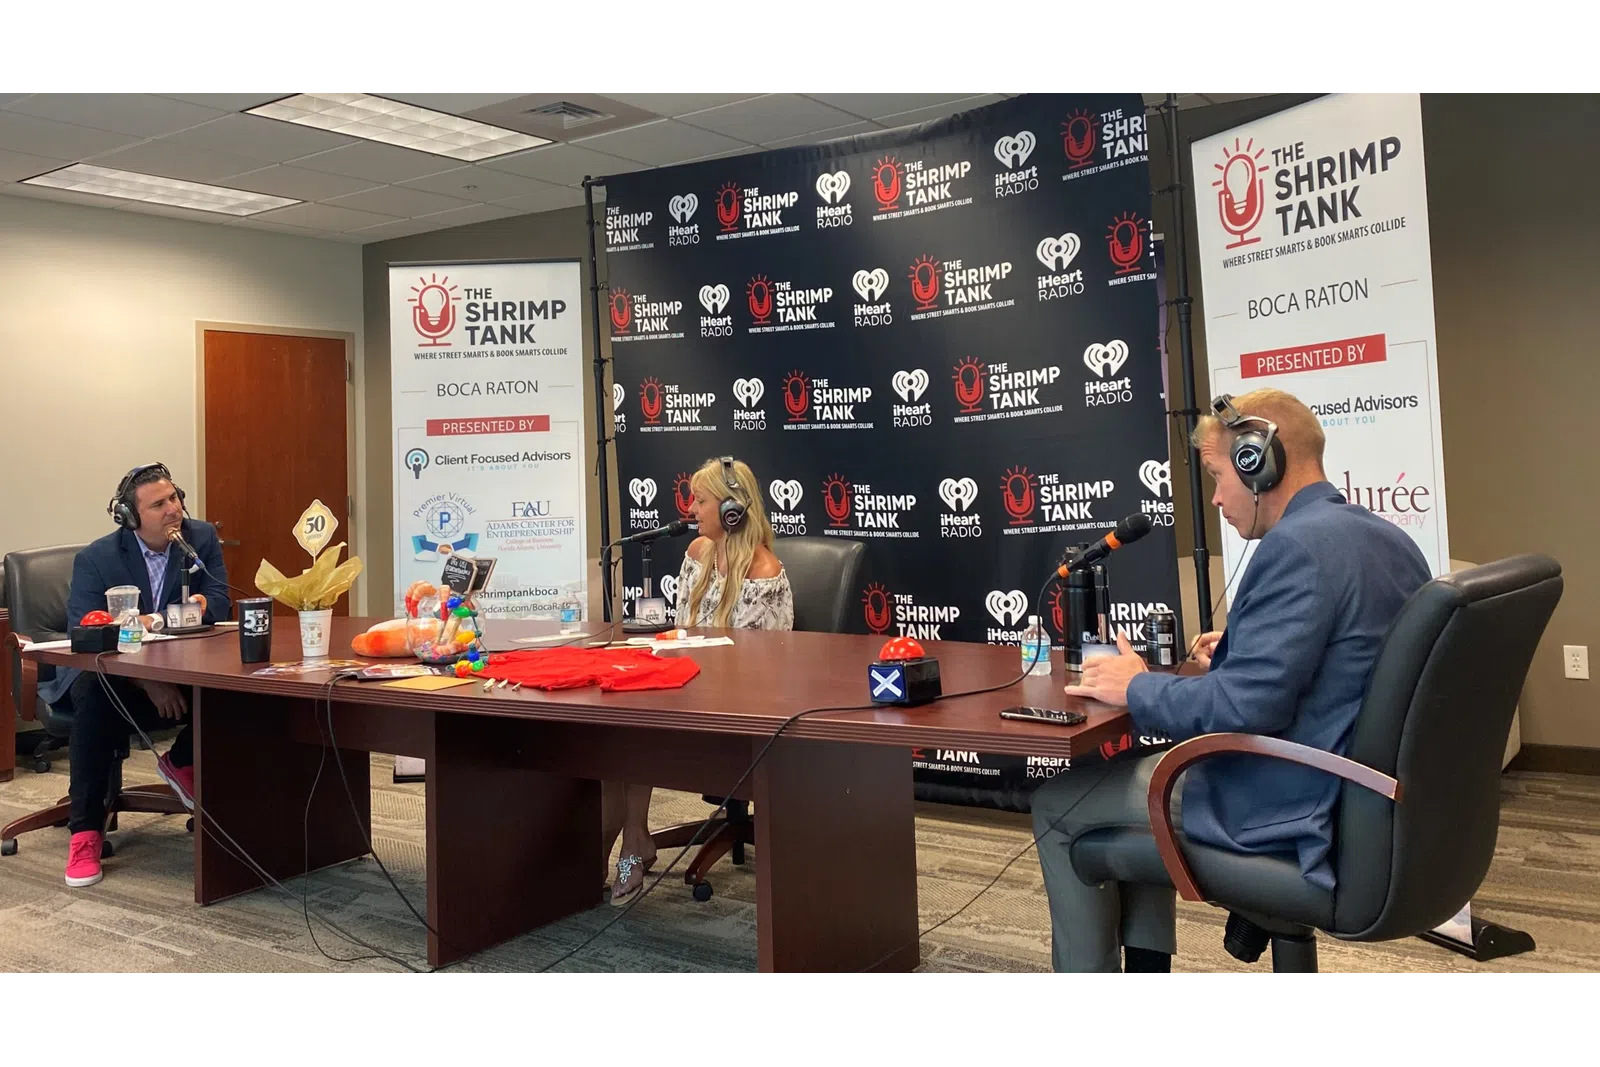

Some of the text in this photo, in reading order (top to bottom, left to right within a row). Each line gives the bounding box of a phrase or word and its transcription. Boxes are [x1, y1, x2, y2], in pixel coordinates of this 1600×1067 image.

[1101, 109, 1123, 123] THE
[1103, 114, 1146, 140] SHRI
[1272, 141, 1304, 166] THE
[905, 161, 923, 172] THE
[1275, 136, 1401, 201] SHRIMP
[906, 161, 971, 189] SHRIMP
[995, 166, 1037, 186] iHeart
[744, 188, 758, 197] THE
[906, 182, 951, 206] TANK
[995, 178, 1039, 198] RADIO
[744, 192, 798, 212] SHRIMP
[607, 207, 619, 215] THE
[817, 204, 852, 218] iHeart
[1276, 185, 1362, 236] TANK
[606, 212, 653, 229] SHRIMP
[744, 210, 782, 228] TANK
[817, 215, 853, 229] RADIO
[607, 229, 639, 244] TANK
[669, 224, 699, 236] iHeart
[669, 234, 700, 246] RADIO
[1223, 217, 1406, 269] WHERE STREET SMARTS & BOOK SMARTS COLLIDE
[943, 260, 962, 271] THE
[945, 262, 1012, 288] SHRIMP
[1038, 269, 1082, 289] iHeart
[464, 288, 492, 299] THE
[775, 282, 791, 291] THE
[1039, 282, 1084, 301] RADIO
[633, 295, 646, 303] THE
[776, 288, 833, 306] SHRIMP
[945, 284, 992, 306] TANK
[1248, 278, 1369, 319] BOCA RATON
[465, 300, 566, 322] SHRIMP
[635, 301, 682, 317] SHRIMP
[777, 305, 817, 322] TANK
[854, 302, 891, 315] iHeart
[635, 317, 669, 332] TANK
[700, 316, 732, 327] iHeart
[854, 314, 892, 327] RADIO
[465, 324, 536, 345] TANK
[701, 326, 732, 337] RADIO
[414, 352, 437, 360] WHERE
[439, 351, 461, 359] STREET
[542, 348, 567, 356] COLLIDE
[1257, 344, 1366, 373] PRESENTED BY
[988, 363, 1007, 374] THE
[812, 379, 828, 388] THE
[989, 366, 1060, 392] SHRIMP
[1085, 377, 1131, 394] iHeart
[437, 380, 538, 396] BOCA RATON
[813, 387, 872, 404] SHRIMP
[666, 393, 715, 408] SHRIMP
[989, 388, 1039, 409] TANK
[1086, 390, 1132, 407] RADIO
[1310, 395, 1418, 415] cused Advisors
[666, 410, 700, 423] TANK
[734, 410, 765, 420] iHeart
[814, 405, 854, 420] TANK
[893, 403, 930, 416] iHeart
[971, 414, 986, 422] STREET
[987, 412, 1005, 420] SMARTS
[1010, 410, 1023, 418] BOOK
[1024, 408, 1043, 416] SMARTS
[1044, 405, 1063, 413] COLLIDE
[443, 420, 534, 433] PRESENTED BY
[734, 421, 766, 431] RADIO
[894, 415, 932, 427] RADIO
[1323, 416, 1376, 427] BOUT YOU
[435, 451, 571, 465] Client Focused Advisors
[1039, 474, 1059, 484] THE
[853, 484, 870, 494] THE
[1040, 480, 1114, 503] SHRIMP
[413, 492, 476, 518] Premier Virtual
[512, 501, 551, 517] FAU
[855, 495, 916, 511] SHRIMP
[1141, 500, 1174, 513] iHea
[630, 508, 658, 518] iHeart
[771, 512, 805, 524] iHeart
[941, 514, 980, 525] iHeart
[1041, 502, 1093, 522] TANK
[305, 515, 325, 534] 50
[486, 522, 519, 530] ADAMS
[521, 520, 555, 529] CENTER
[855, 512, 899, 528] TANK
[1021, 526, 1038, 534] STREET
[1039, 525, 1057, 533] SMARTS
[1097, 520, 1118, 529] COLLIDE
[486, 528, 574, 538] ENTREPRENEURSHIP
[941, 526, 982, 537] RADIO
[894, 594, 913, 604] THE
[896, 605, 960, 623] SHRIMP
[897, 623, 941, 640] TANK
[987, 628, 1026, 640] iHear
[1109, 623, 1146, 640] ANK
[982, 768, 1000, 776] COLLIDE
